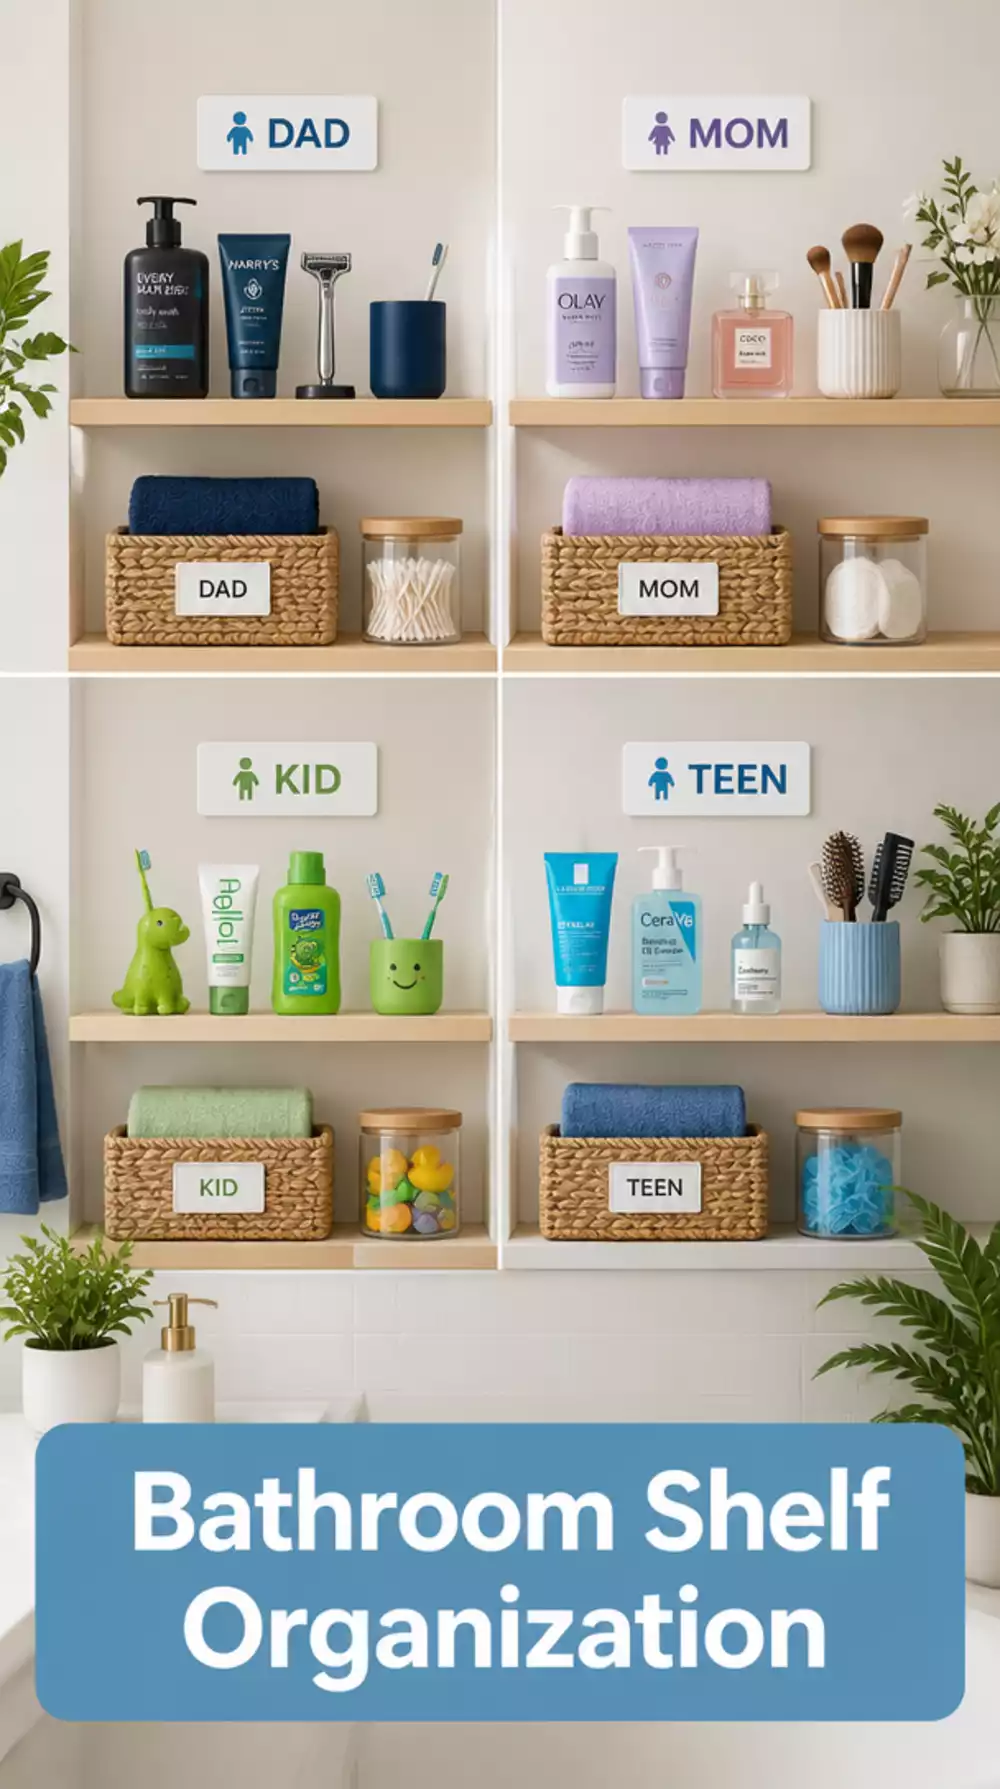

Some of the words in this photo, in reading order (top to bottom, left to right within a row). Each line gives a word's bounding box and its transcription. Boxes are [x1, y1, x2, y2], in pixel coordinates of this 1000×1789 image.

[268, 117, 351, 149] DAD
[689, 117, 789, 149] MOM
[557, 292, 607, 310] OLAY
[198, 579, 248, 599] DAD
[638, 579, 700, 600] MOM
[275, 763, 342, 795] KID
[687, 763, 788, 795] TEEN
[199, 1178, 239, 1197] KID
[626, 1177, 684, 1197] TEEN
